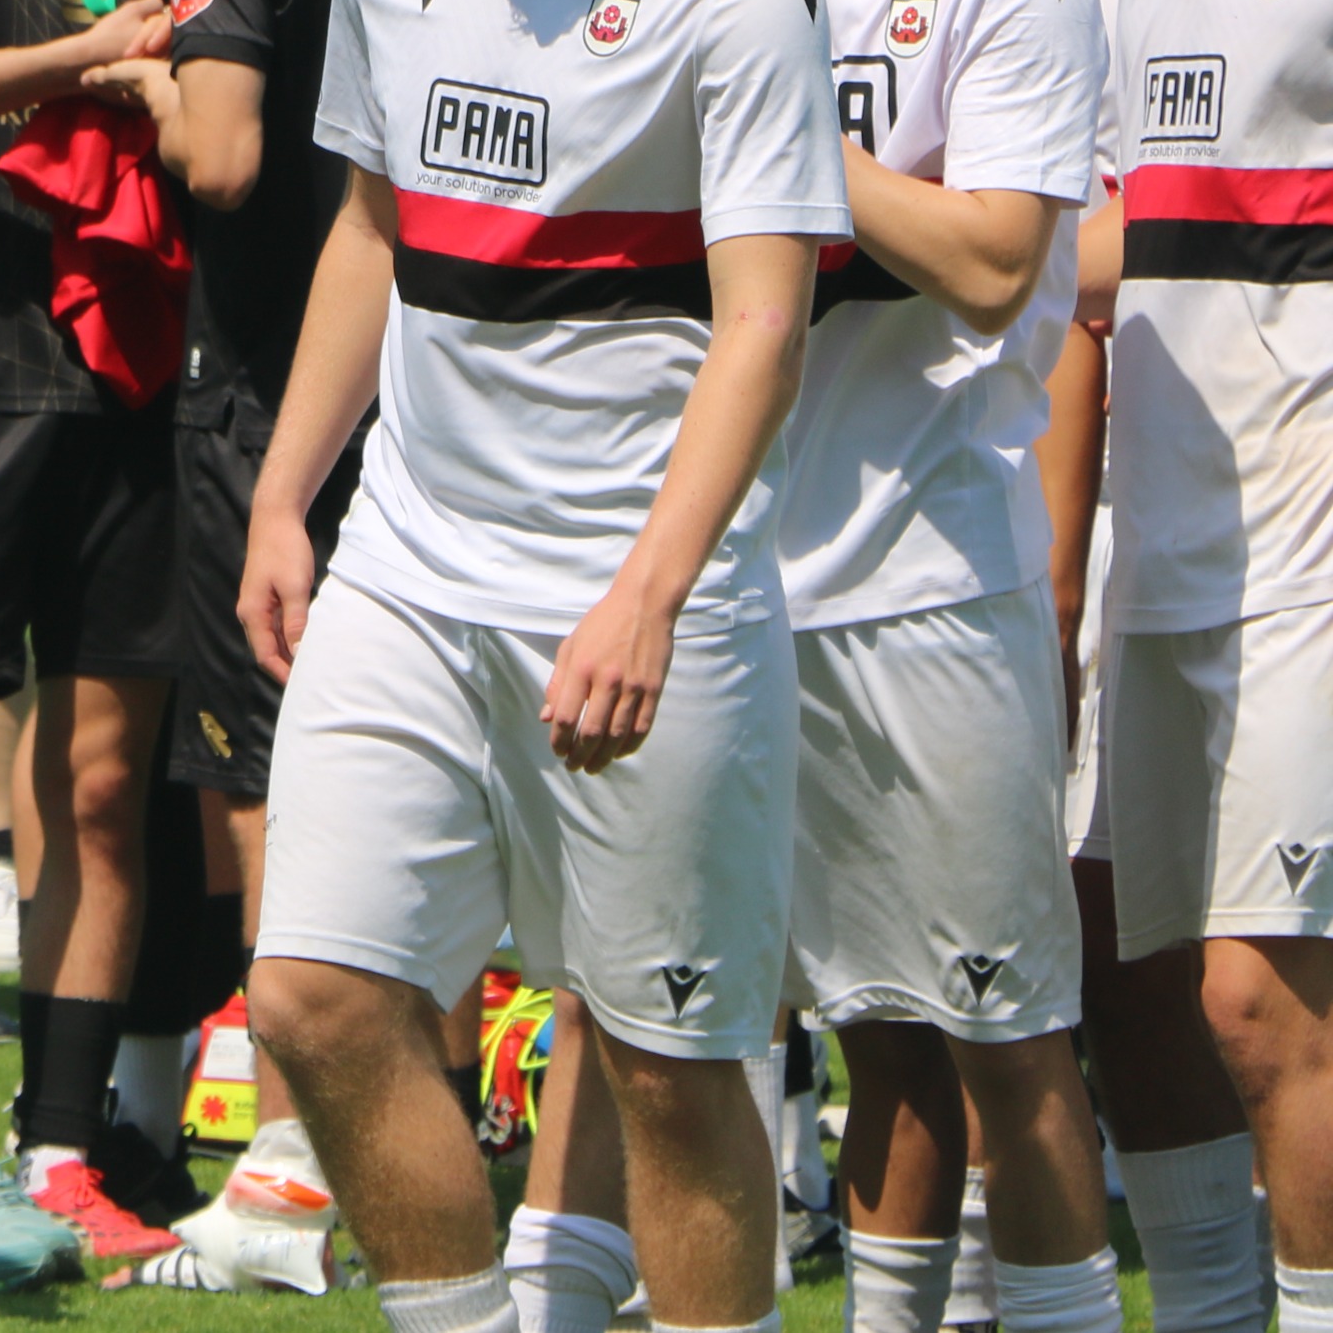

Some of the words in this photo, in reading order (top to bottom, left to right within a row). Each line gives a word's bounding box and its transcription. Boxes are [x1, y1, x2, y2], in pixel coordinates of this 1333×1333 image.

[1146, 70, 1214, 129] PAMA
[433, 95, 535, 170] PAMA
[416, 172, 442, 186] your
[445, 176, 491, 196] solution
[494, 187, 542, 203] provider
